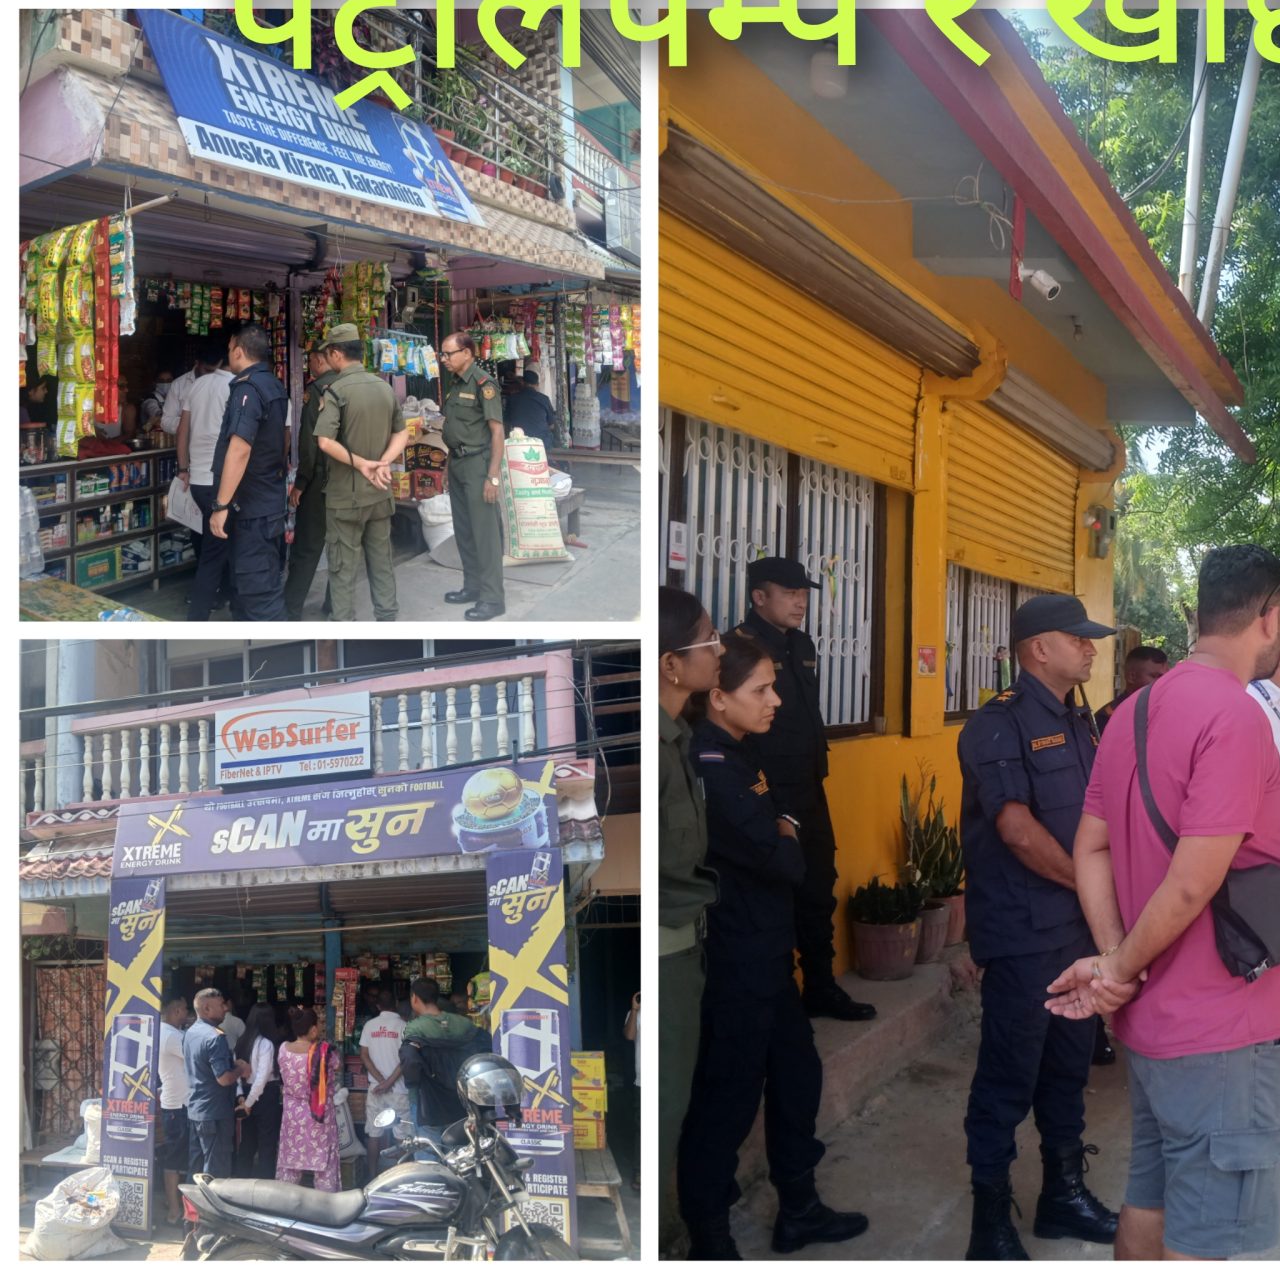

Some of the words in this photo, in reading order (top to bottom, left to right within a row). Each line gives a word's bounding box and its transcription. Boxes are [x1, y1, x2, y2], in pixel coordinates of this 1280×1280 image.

[205, 36, 367, 131] XTREME
[225, 82, 317, 135] ENERGY
[317, 116, 381, 156] DRINK
[222, 109, 258, 131] TASTE
[257, 120, 280, 138] THE
[331, 144, 352, 162] FEEL
[194, 125, 281, 171] Anuska
[279, 150, 347, 190] Kirana,
[342, 168, 427, 209] Kakarbhitta
[232, 718, 361, 753] WebSurfer
[220, 767, 254, 780] FiberNet
[255, 766, 262, 777] &
[263, 764, 283, 776] IPTV
[317, 755, 365, 770] 01-5970222
[409, 780, 445, 793] FOOTBALL
[210, 809, 308, 855] sCAN
[306, 818, 345, 842] मा
[344, 801, 437, 855] सुन
[120, 859, 153, 869] ENERGY
[154, 857, 182, 866] DRINK
[122, 842, 182, 862] XTREME
[488, 873, 530, 897] sCAN
[111, 898, 143, 918] sCAN
[501, 885, 559, 926] सुन
[119, 911, 163, 942] सुन
[107, 1099, 150, 1115] XTREME
[520, 1138, 543, 1146] CLASSIC
[103, 1154, 117, 1165] SCAN
[123, 1156, 149, 1167] REGISTER
[111, 1163, 149, 1177] PARTICIPATE
[532, 1173, 569, 1186] REGISTER
